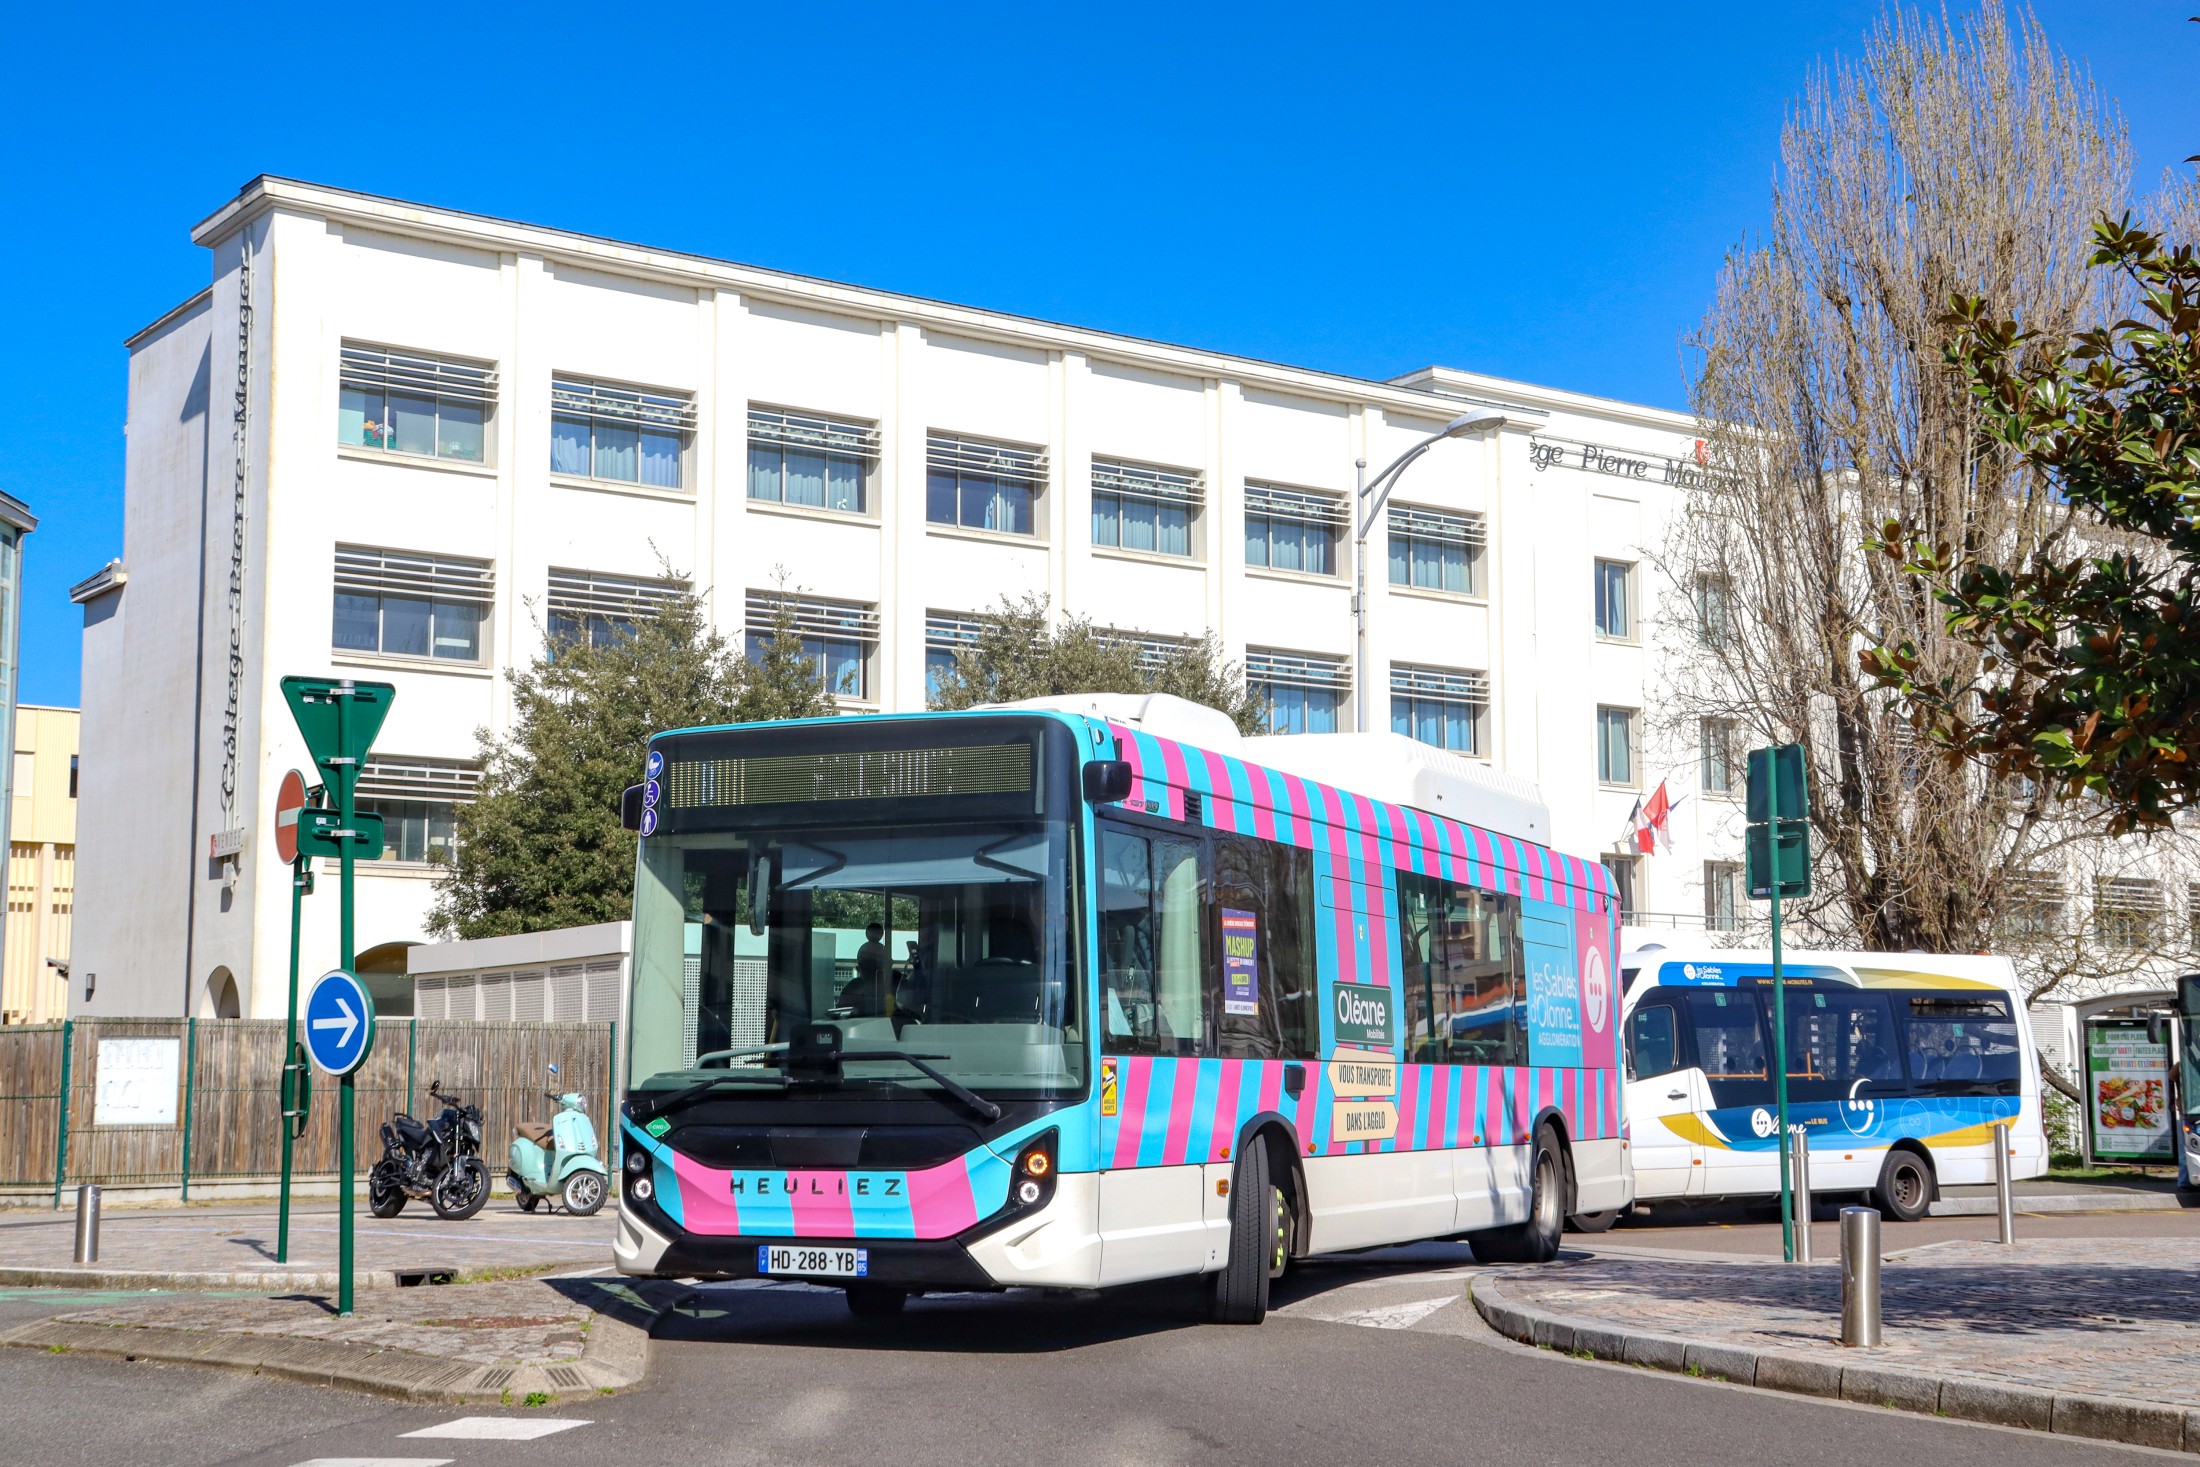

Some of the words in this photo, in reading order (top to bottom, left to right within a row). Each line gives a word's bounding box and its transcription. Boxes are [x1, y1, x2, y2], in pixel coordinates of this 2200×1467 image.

[1582, 444, 1648, 478] Pierre
[1226, 935, 1254, 958] MASHUP
[1531, 962, 1544, 992] les
[1544, 963, 1577, 999] Sables
[1366, 1029, 1385, 1039] Mobilités
[1339, 1064, 1355, 1084] VOUS
[1356, 1066, 1392, 1087] TRANSPORTE
[1346, 1112, 1362, 1131] DANS
[1363, 1111, 1386, 1131] L'AGGLO
[729, 1177, 901, 1196] HEULIEZ
[771, 1249, 855, 1273] HD-288-YB
